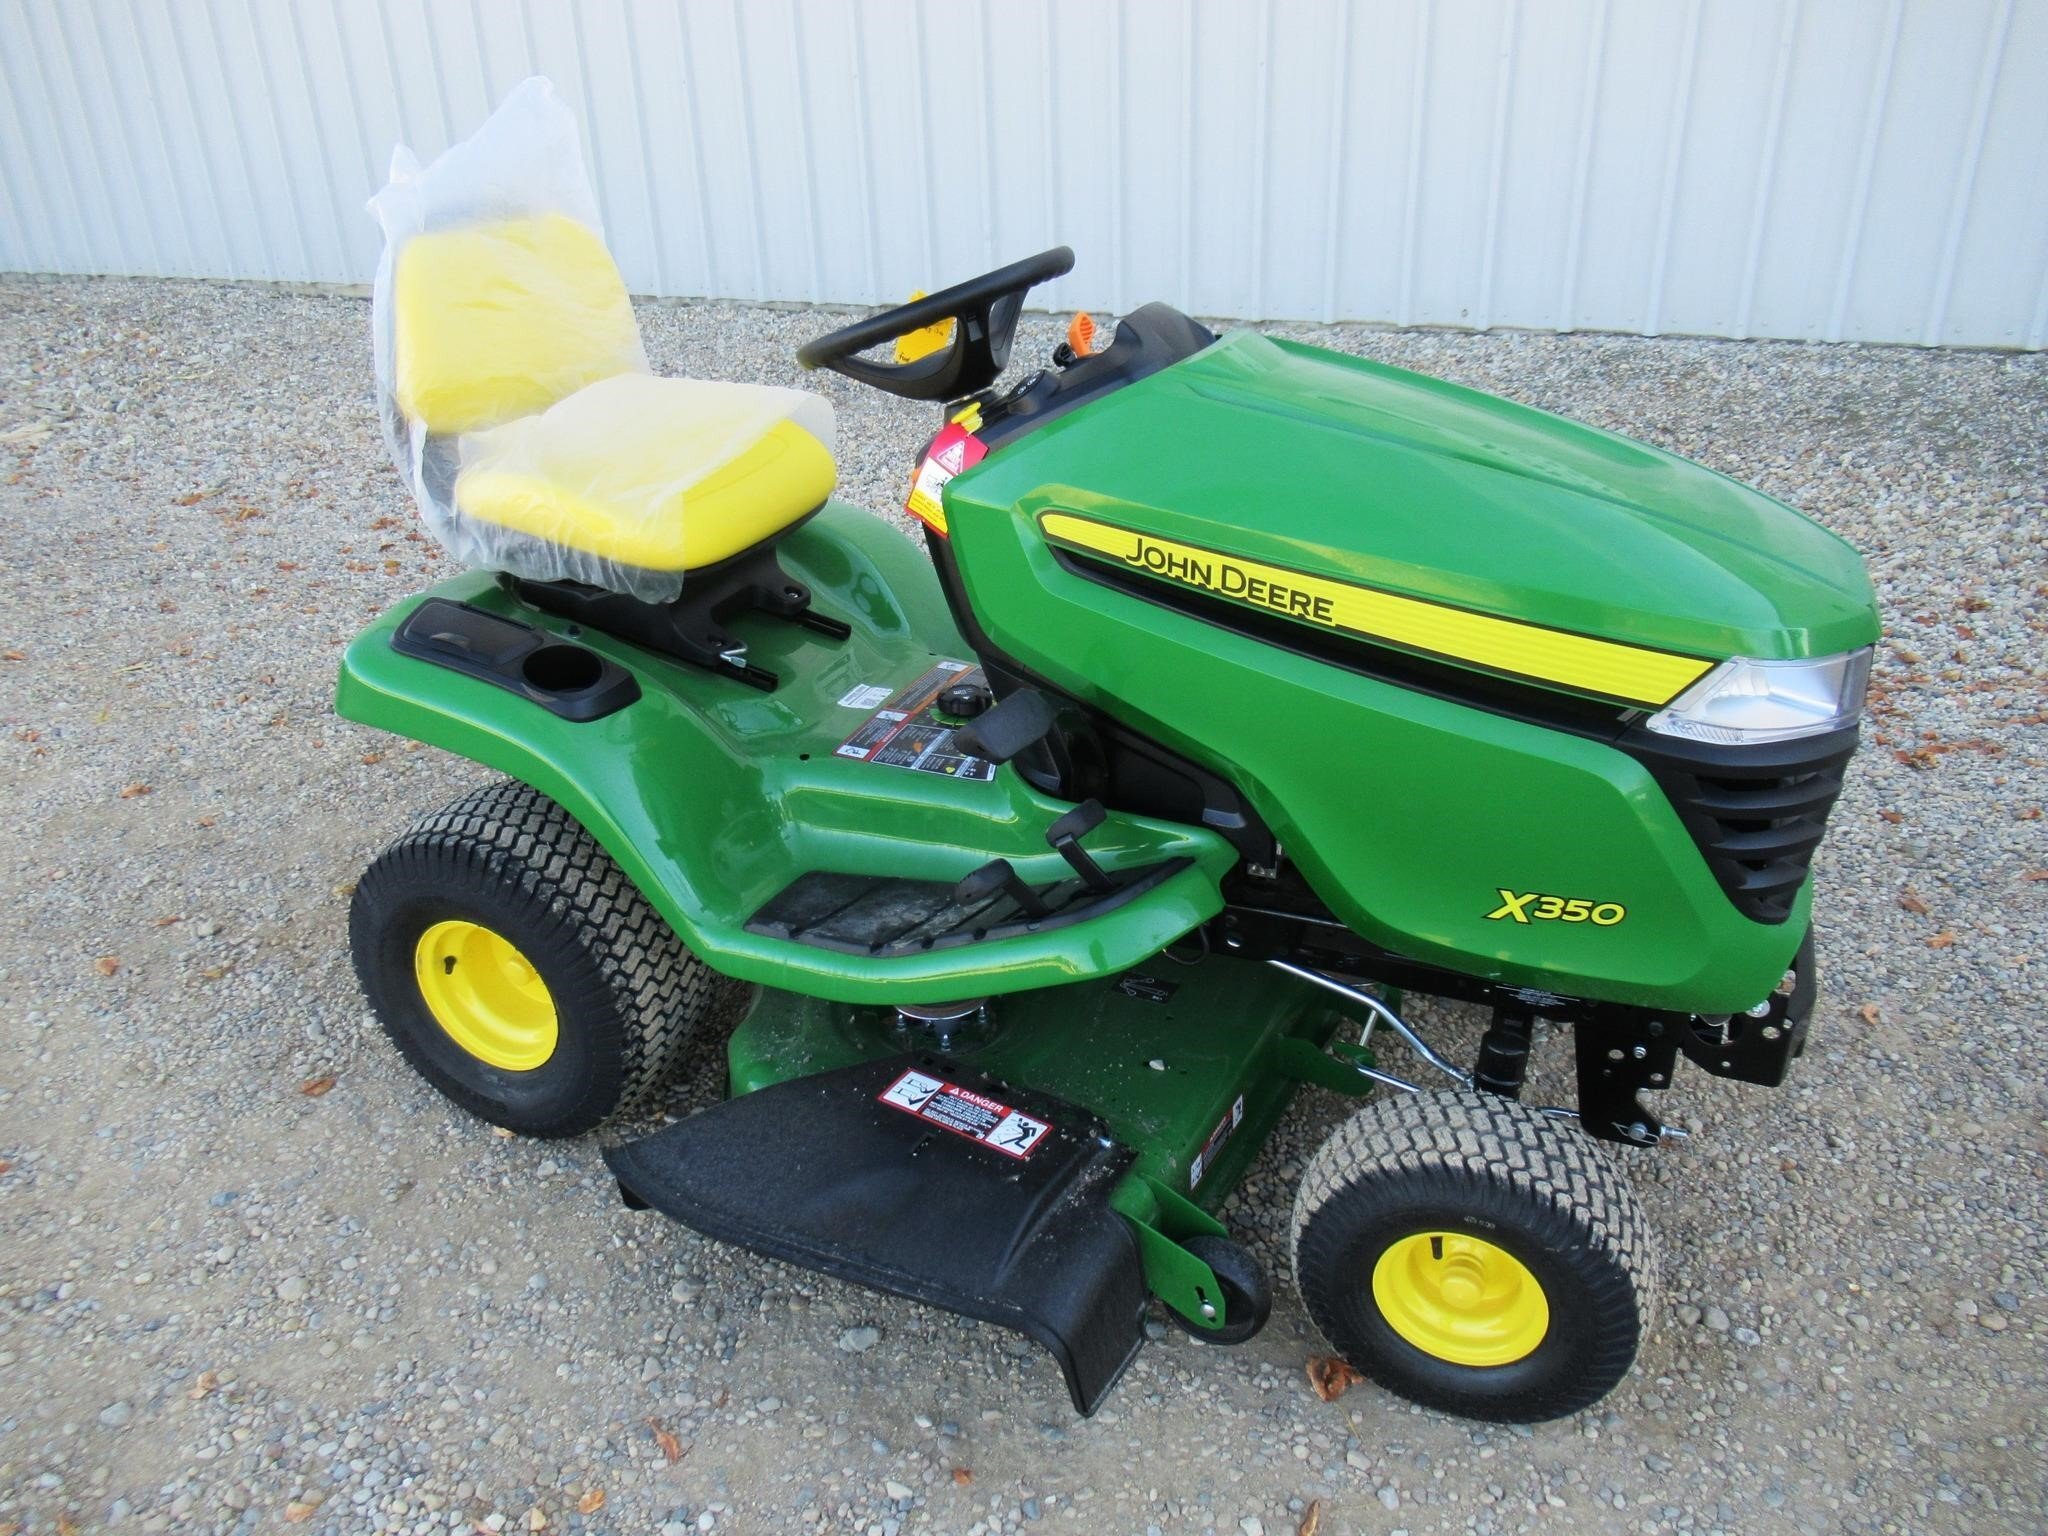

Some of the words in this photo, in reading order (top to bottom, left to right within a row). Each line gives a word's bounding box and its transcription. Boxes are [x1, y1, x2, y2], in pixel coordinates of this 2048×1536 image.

[1125, 538, 1212, 586] JOHN
[1221, 563, 1334, 622] DEERE
[1483, 888, 1627, 926] X350
[960, 1091, 1004, 1112] DANGER
